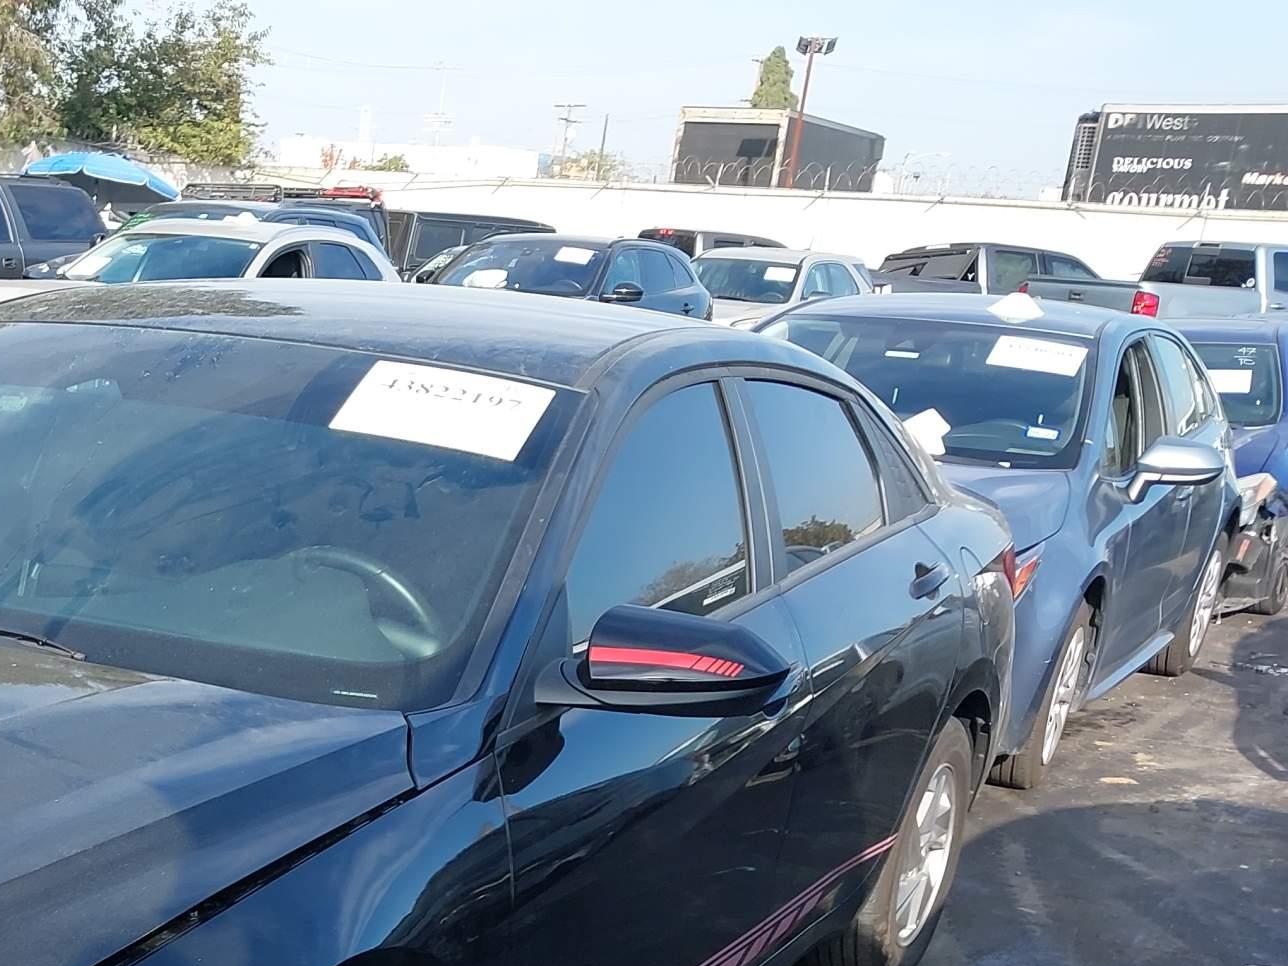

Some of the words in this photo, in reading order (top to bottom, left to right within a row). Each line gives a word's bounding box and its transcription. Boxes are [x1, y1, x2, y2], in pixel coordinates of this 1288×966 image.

[1146, 114, 1190, 130] West
[1112, 156, 1193, 170] DELICIOUS
[381, 378, 522, 408] 43822197
